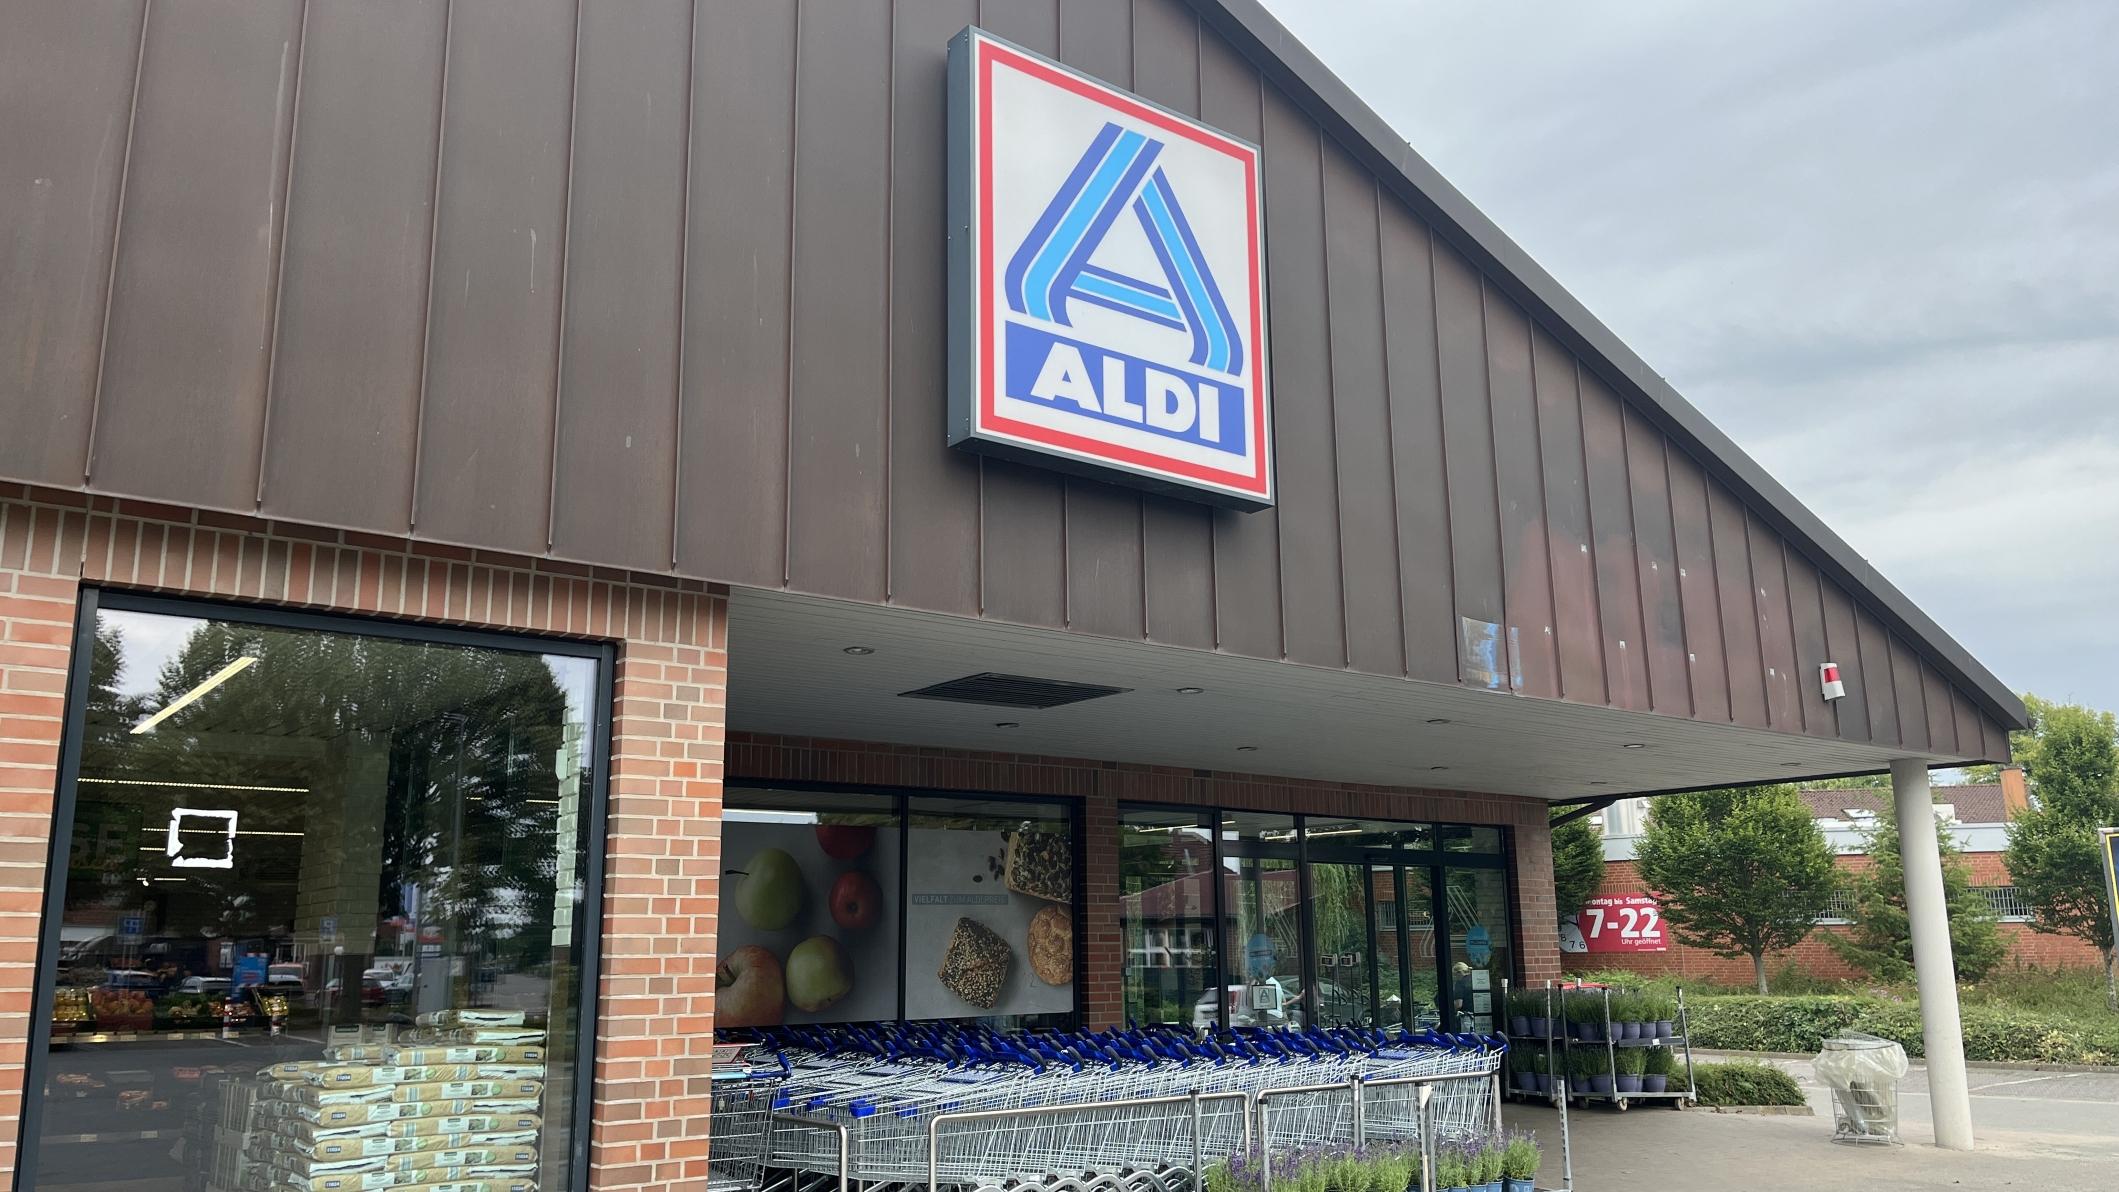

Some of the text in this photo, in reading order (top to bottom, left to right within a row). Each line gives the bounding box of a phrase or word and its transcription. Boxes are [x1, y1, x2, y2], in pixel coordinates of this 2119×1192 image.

[1029, 341, 1220, 443] ALDI
[914, 895, 948, 904] VIELFALT
[1586, 898, 1613, 906] ontag
[1625, 897, 1658, 905] Samstag
[1586, 907, 1661, 938] 7-22
[1635, 938, 1661, 946] geöffnet
